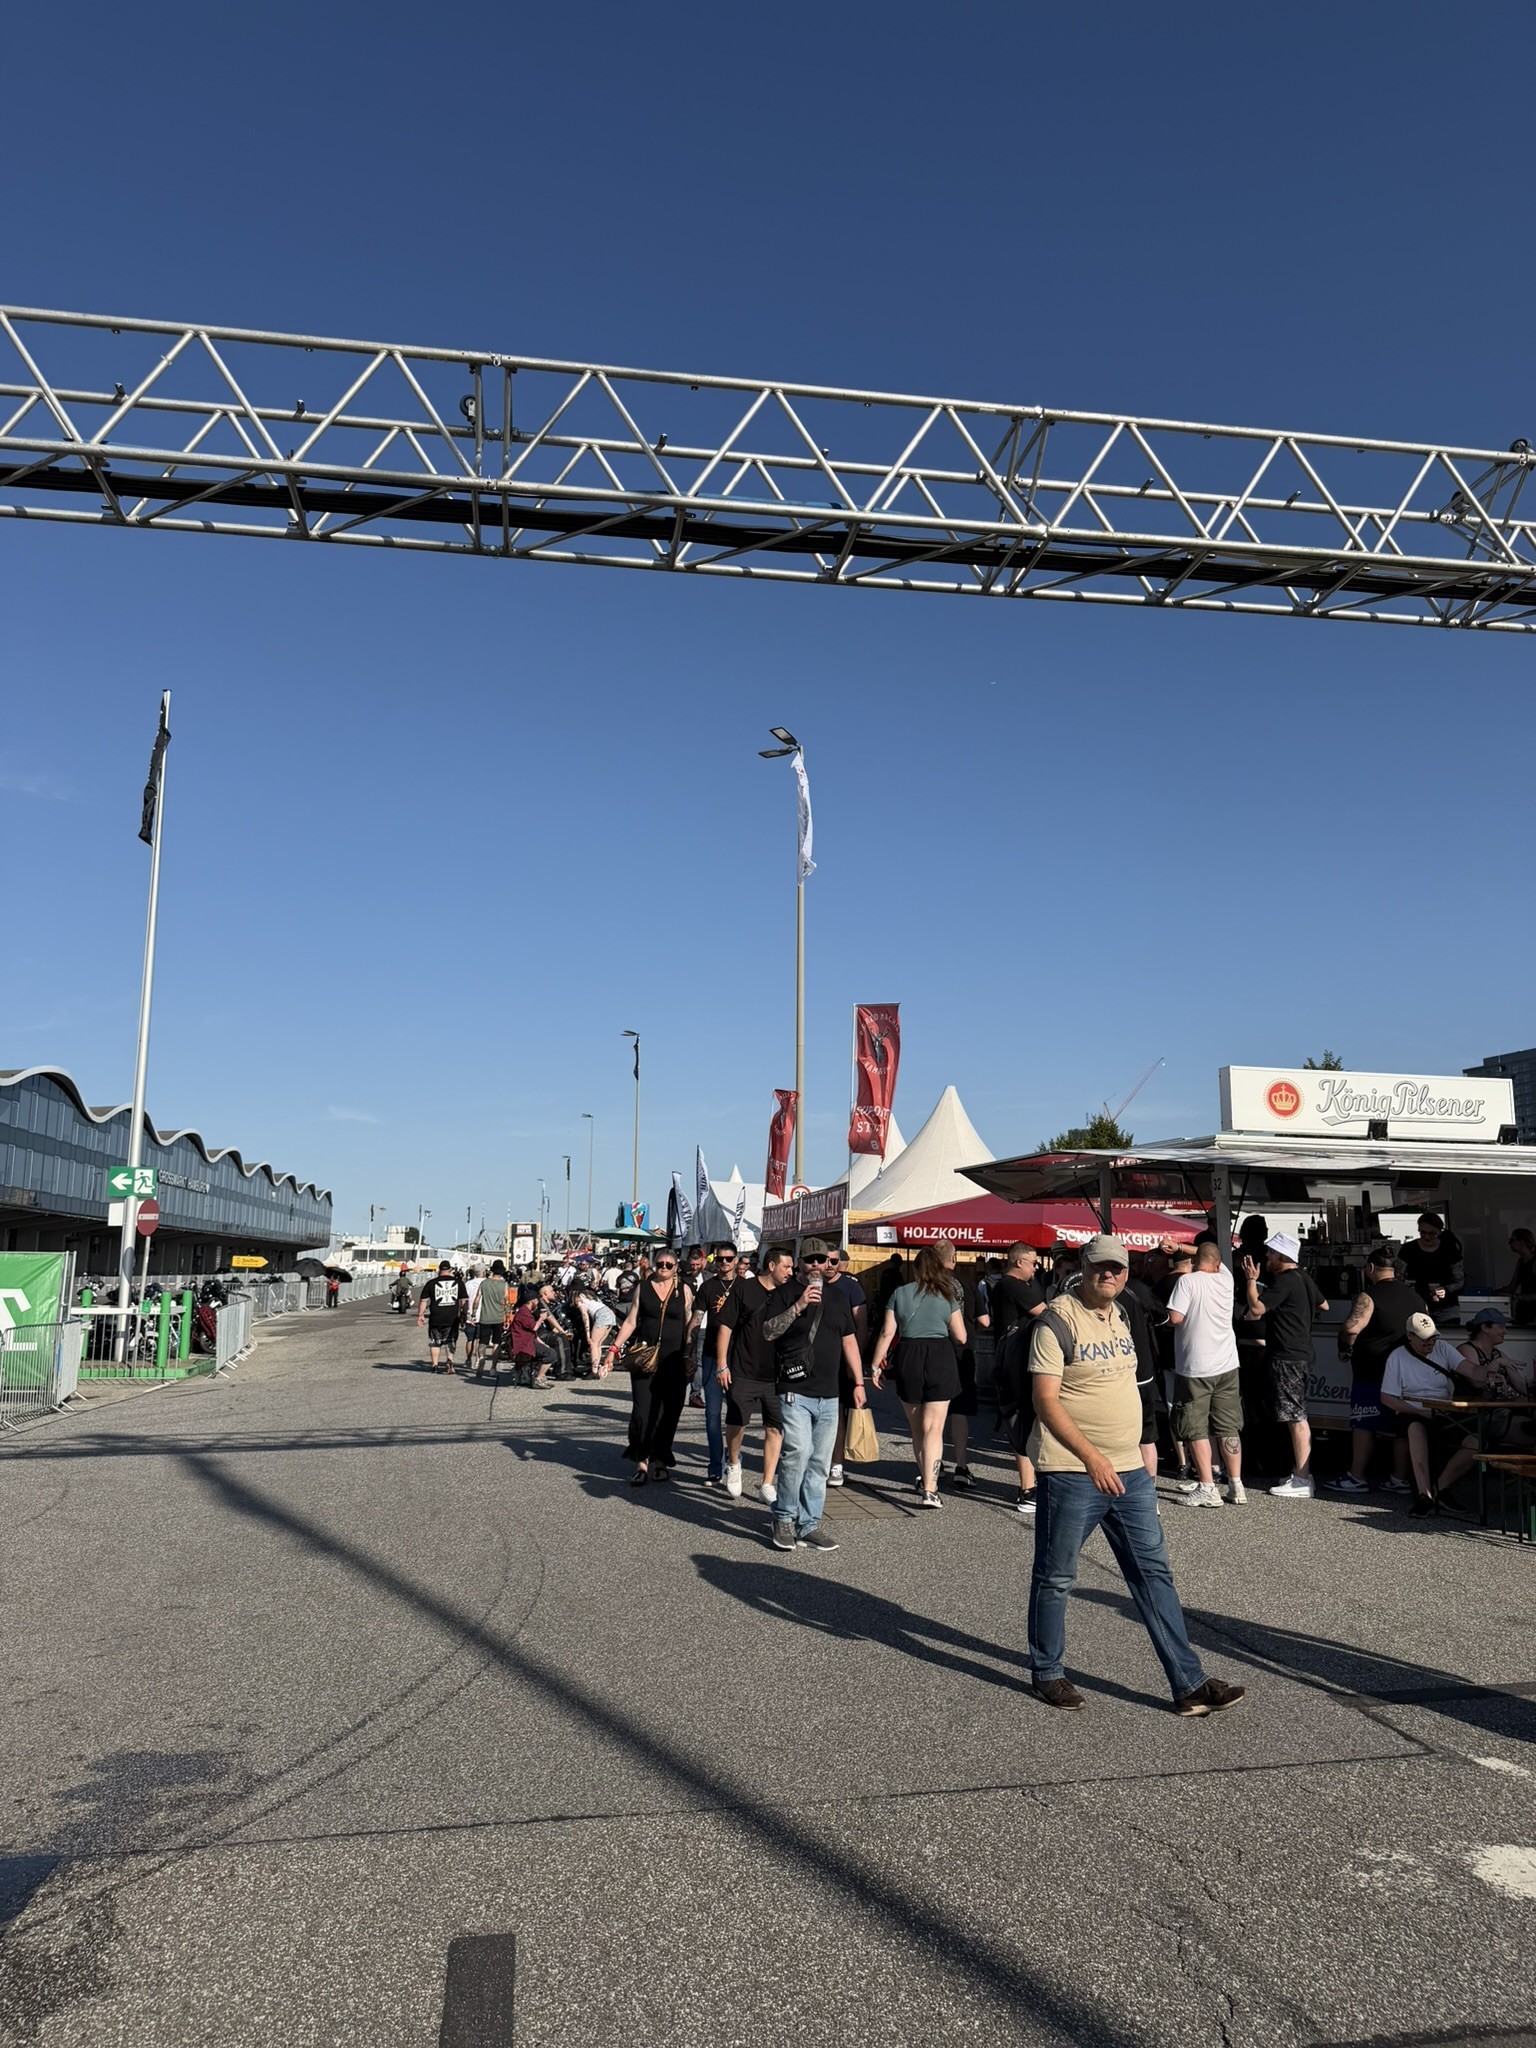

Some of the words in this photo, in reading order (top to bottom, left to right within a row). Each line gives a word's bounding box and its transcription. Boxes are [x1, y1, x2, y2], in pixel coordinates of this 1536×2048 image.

[1316, 1079, 1392, 1119] König
[1390, 1080, 1486, 1117] Pilsener
[1213, 1177, 1222, 1191] 32
[827, 1188, 846, 1218] CITY
[903, 1226, 985, 1240] HOLZKOHLE
